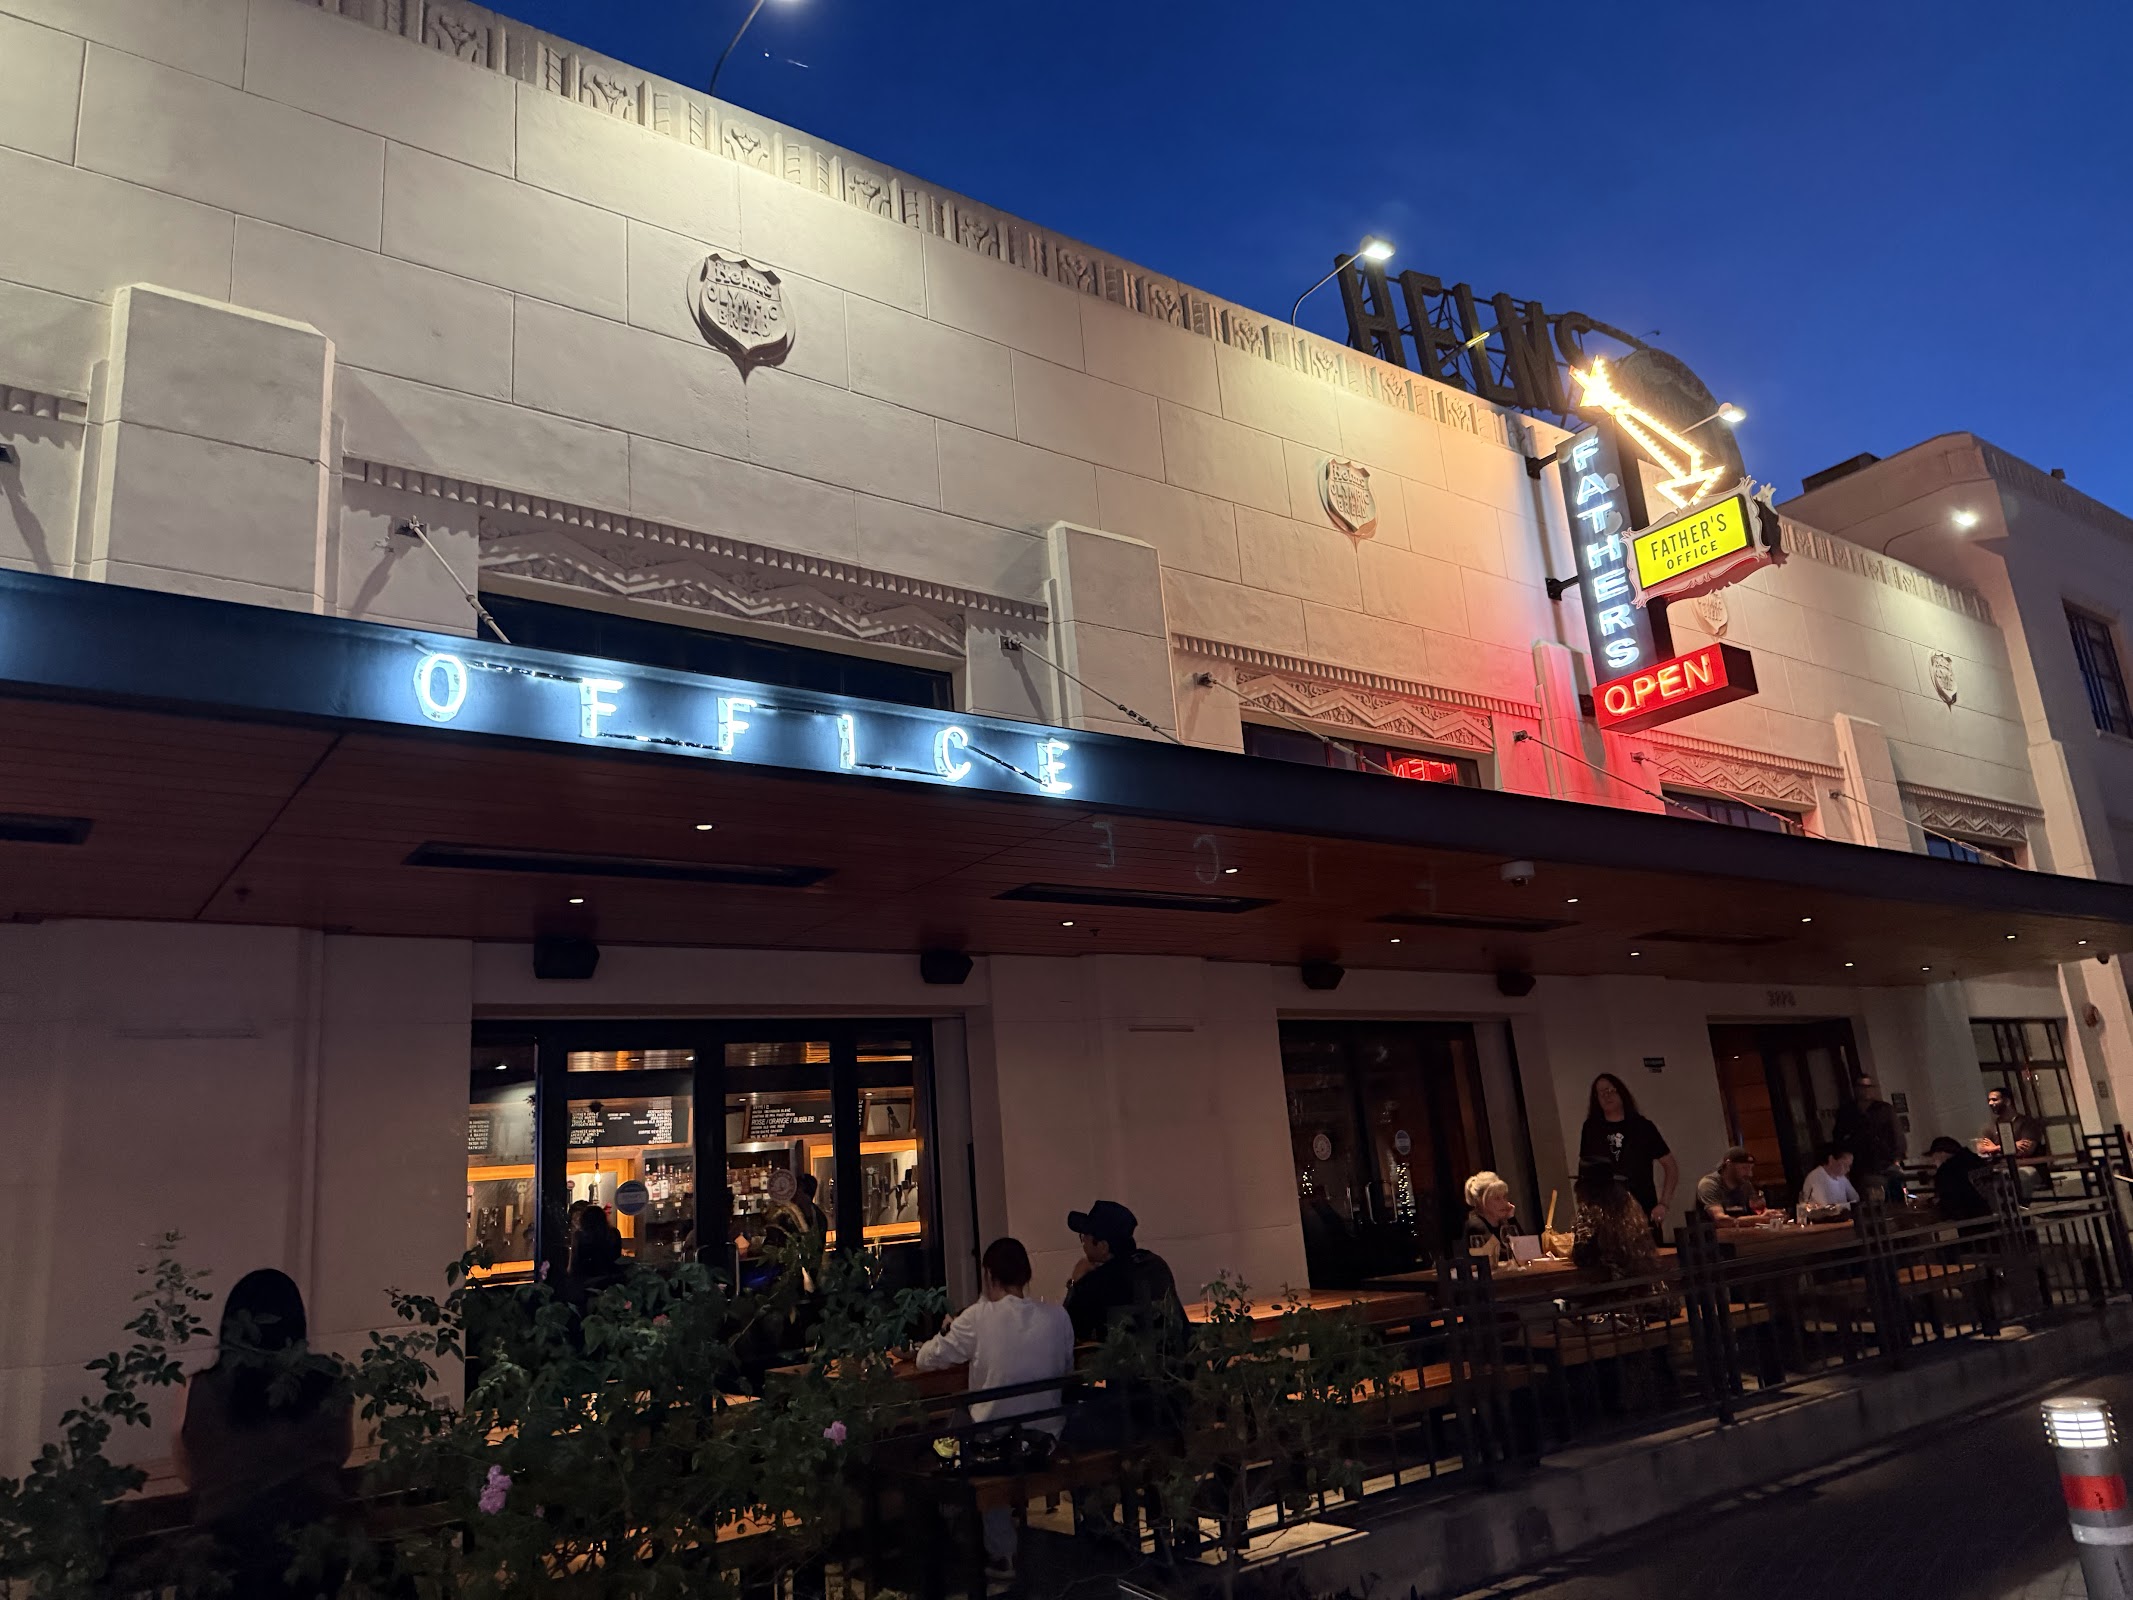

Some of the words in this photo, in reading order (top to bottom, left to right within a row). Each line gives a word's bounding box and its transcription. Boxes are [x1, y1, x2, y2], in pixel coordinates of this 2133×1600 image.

[714, 260, 773, 298] Helms
[706, 284, 779, 321] OLYMPIC
[718, 308, 771, 338] BREAD
[1572, 437, 1640, 669] FATHERS
[1651, 513, 1727, 561] FATHER'S
[1666, 540, 1719, 570] OFFICE
[1604, 653, 1715, 717] OPEN
[414, 651, 1074, 793] OFFICE
